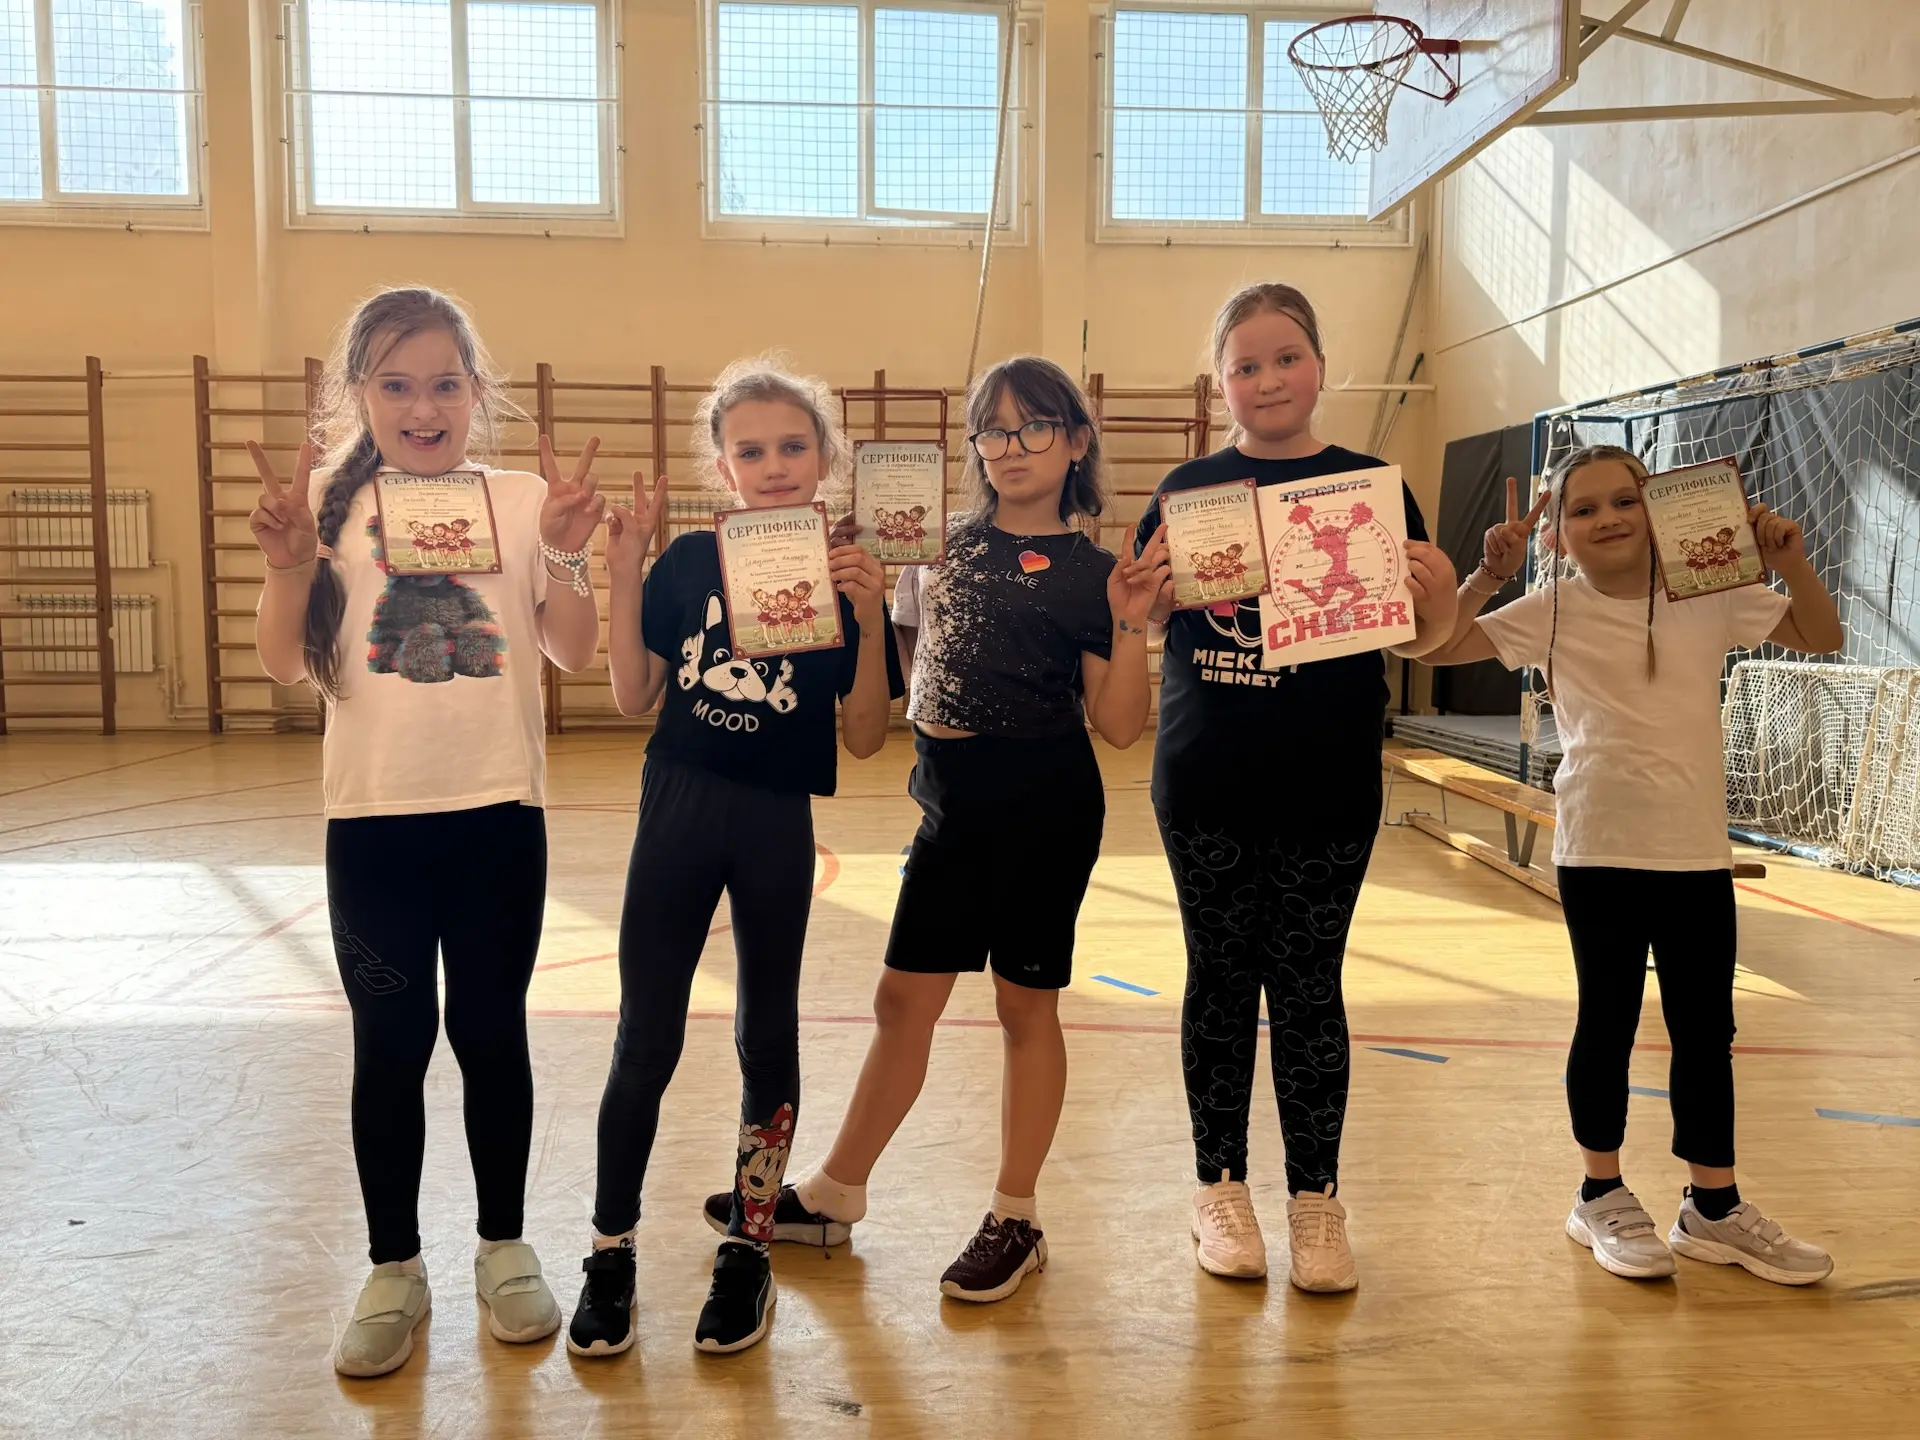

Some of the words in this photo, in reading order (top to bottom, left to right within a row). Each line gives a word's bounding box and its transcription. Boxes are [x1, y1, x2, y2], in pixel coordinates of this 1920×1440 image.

[862, 453, 939, 465] СЕРТИФИКАТ
[384, 477, 477, 486] СЕРТИФИКАТ
[1649, 473, 1732, 500] СЕРТИФИКАТ
[1169, 493, 1249, 515] СЕРТИФИКАТ
[727, 518, 819, 540] СЕРТИФИКАТ
[1006, 570, 1039, 590] LIKE
[1268, 601, 1409, 650] CHEER
[1192, 648, 1299, 674] MICK
[1201, 668, 1281, 688] DISNEY
[692, 699, 760, 732] MOOD
